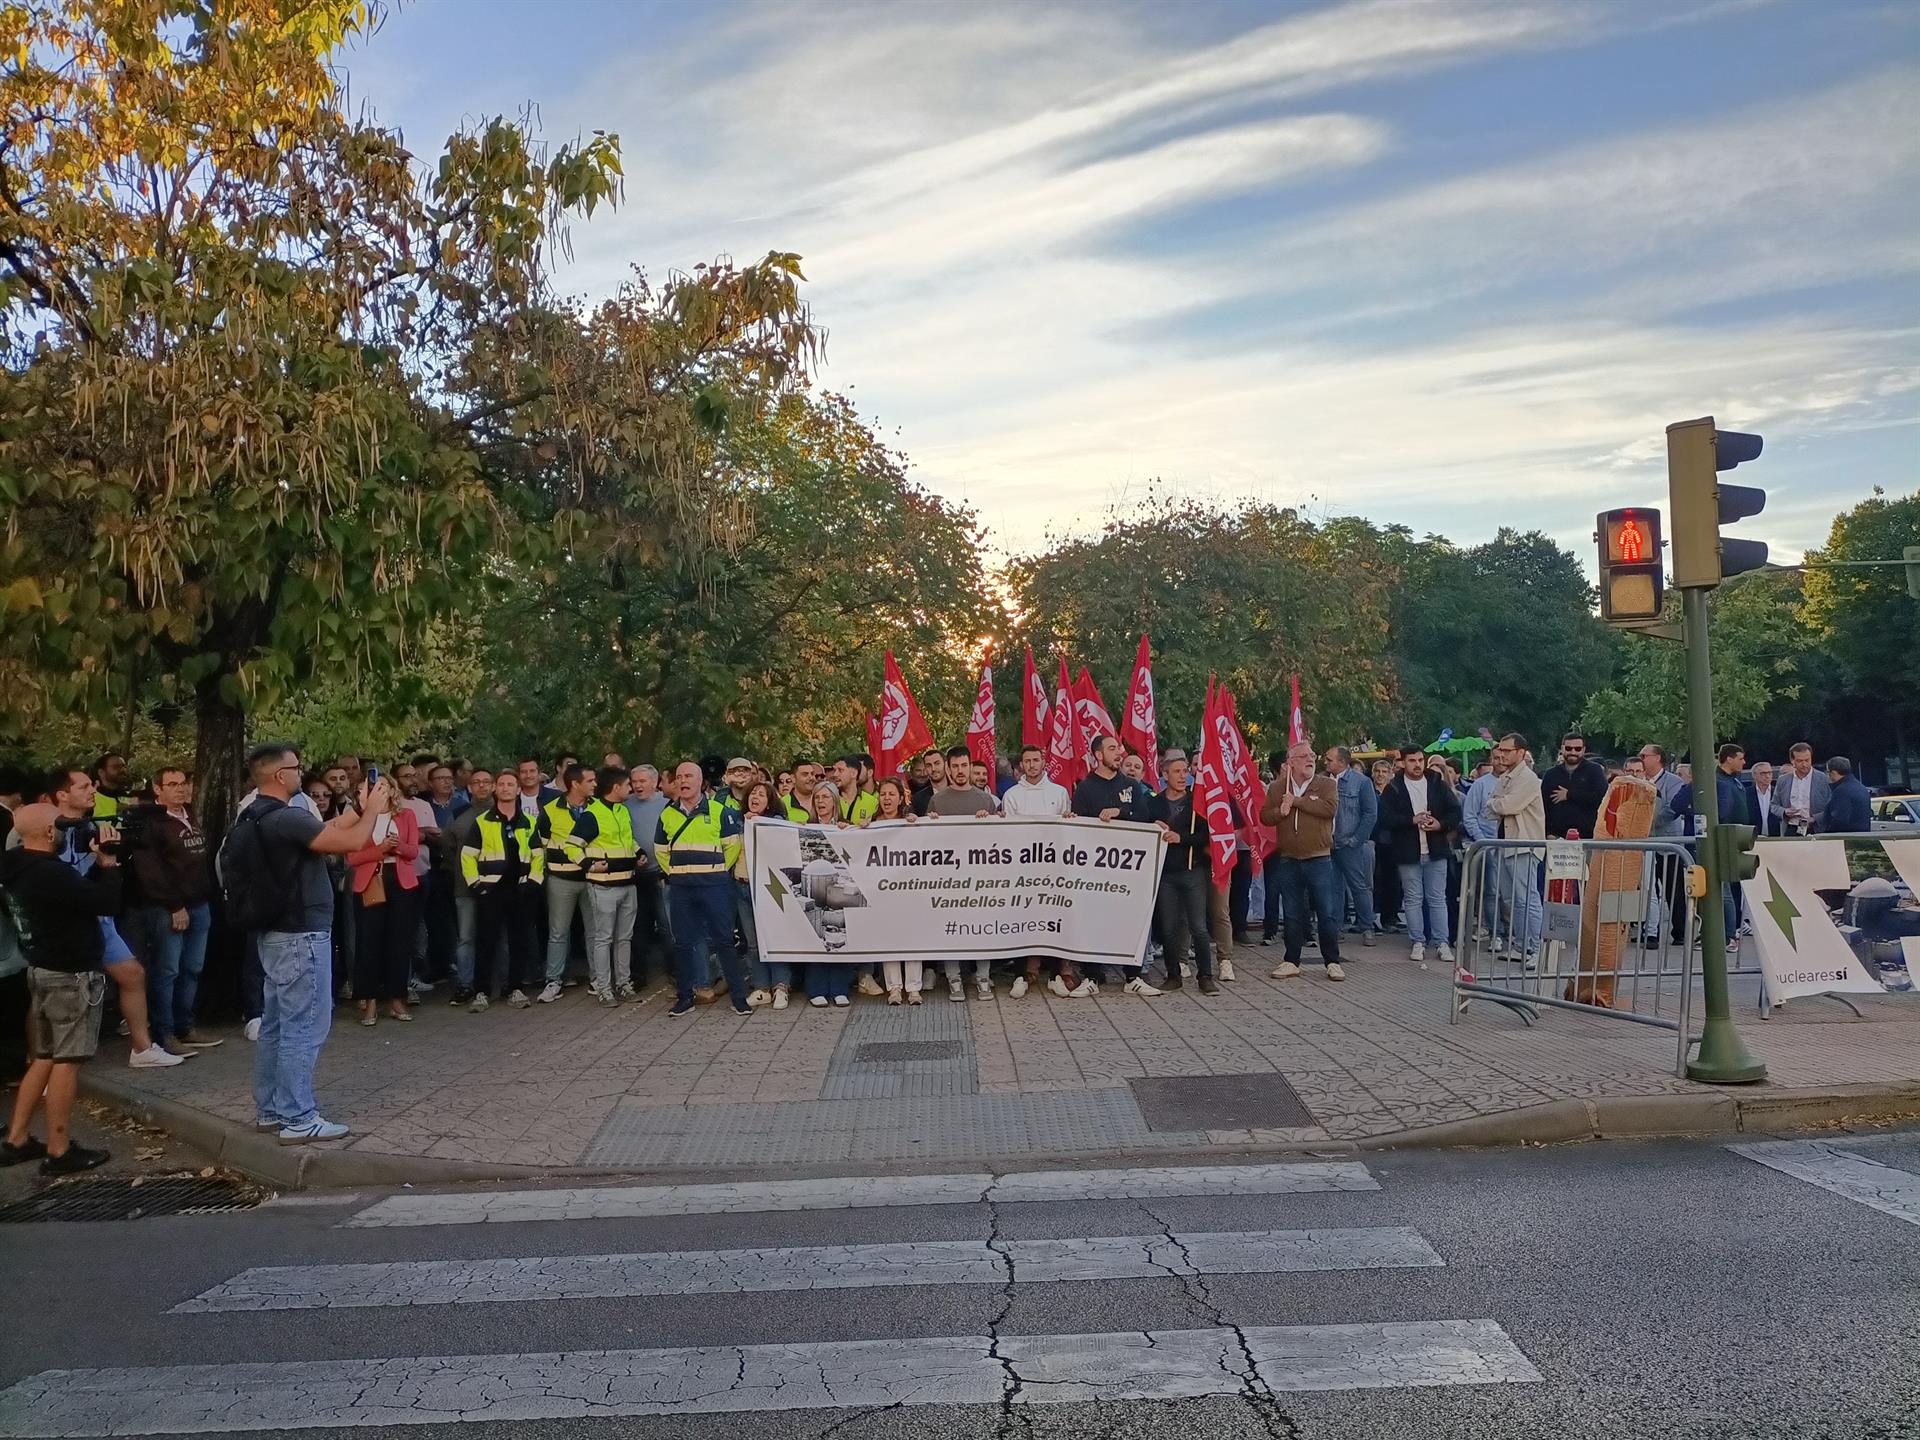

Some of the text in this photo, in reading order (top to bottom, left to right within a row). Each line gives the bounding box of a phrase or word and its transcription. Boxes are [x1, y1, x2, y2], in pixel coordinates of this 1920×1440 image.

[1202, 763, 1237, 865] FICA
[866, 842, 1147, 871] Almaraz, más allá de 2027
[877, 876, 971, 891] Continuidad
[974, 879, 1010, 892] para
[931, 895, 1006, 909] Vandellós
[1023, 897, 1033, 909] y
[1037, 893, 1073, 908] Trillo
